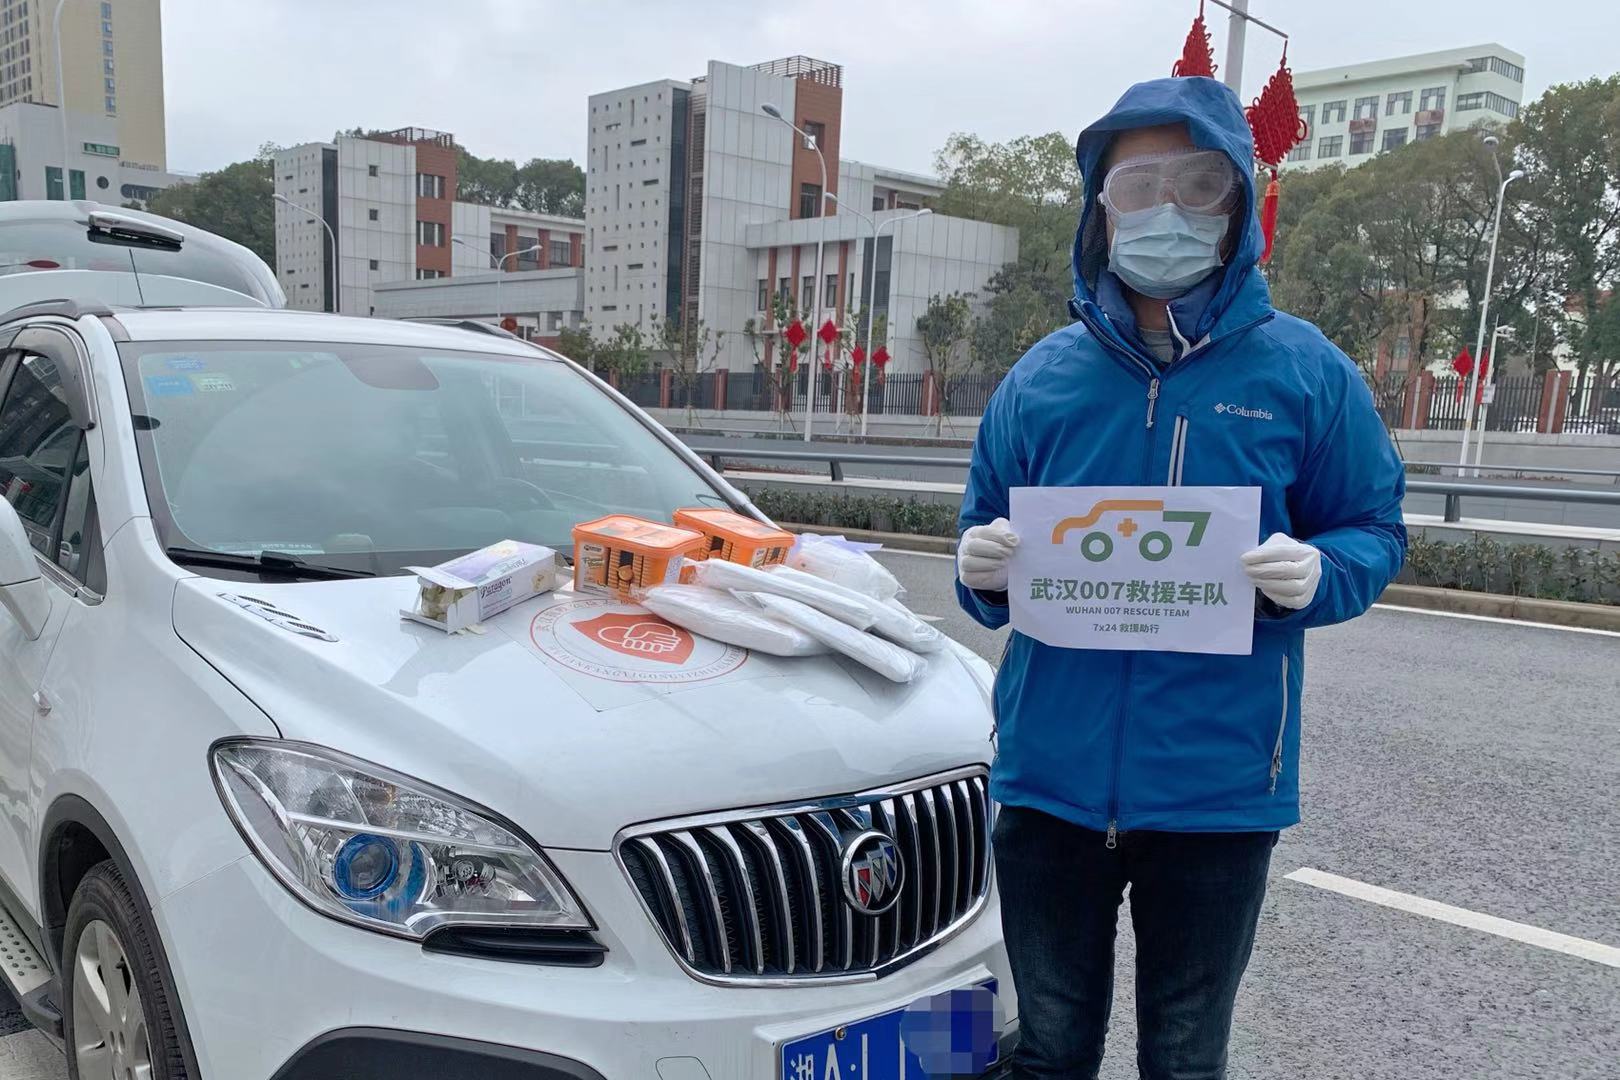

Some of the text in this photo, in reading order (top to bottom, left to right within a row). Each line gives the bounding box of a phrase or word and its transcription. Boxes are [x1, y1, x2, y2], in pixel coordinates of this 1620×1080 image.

[1226, 404, 1273, 419] Columbia
[1030, 578, 1228, 606] 武汉007救援车队
[1066, 606, 1190, 617] WUHAN 007 RESCUE TEAM
[1093, 624, 1160, 634] 7x24 救援助行
